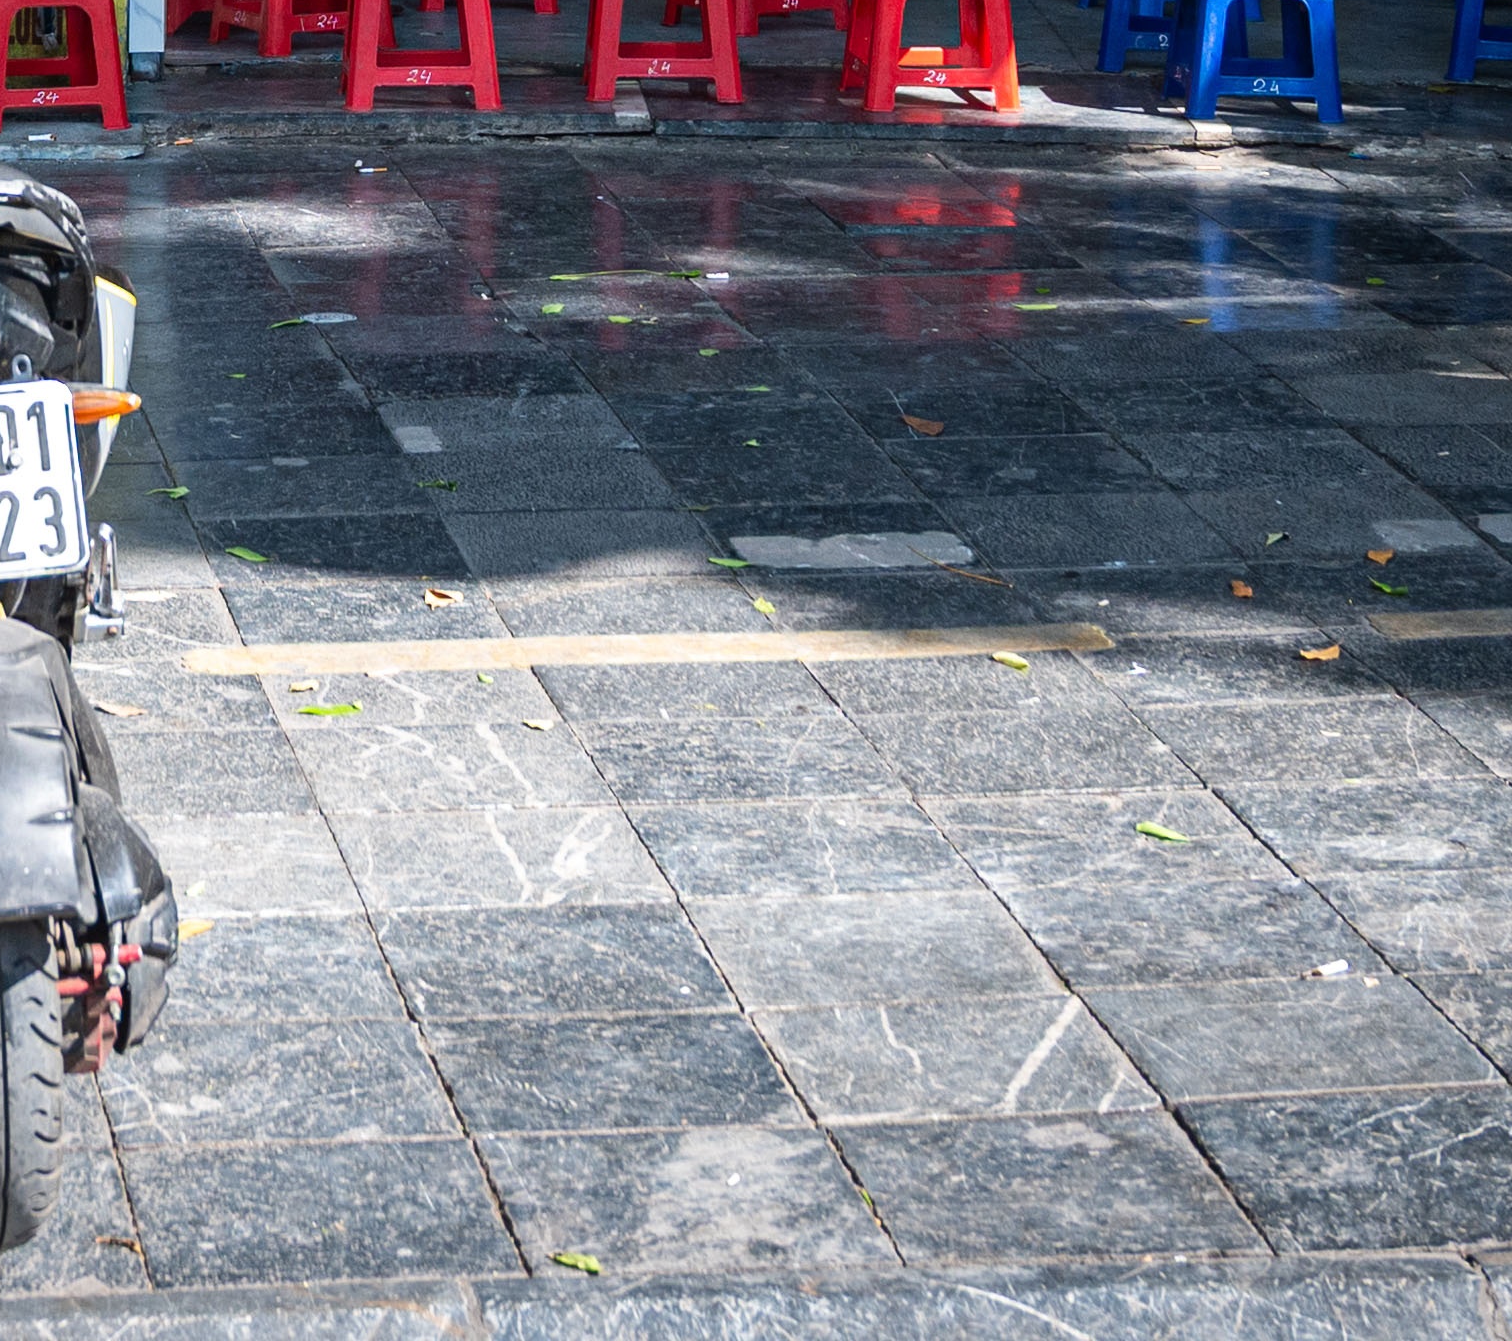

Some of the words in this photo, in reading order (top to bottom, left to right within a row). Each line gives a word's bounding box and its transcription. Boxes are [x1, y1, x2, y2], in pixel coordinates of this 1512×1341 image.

[317, 13, 338, 30] 24
[647, 59, 671, 75] 24
[406, 69, 433, 85] 24
[923, 69, 948, 85] 24
[1253, 78, 1280, 95] 24
[32, 90, 60, 105] 24
